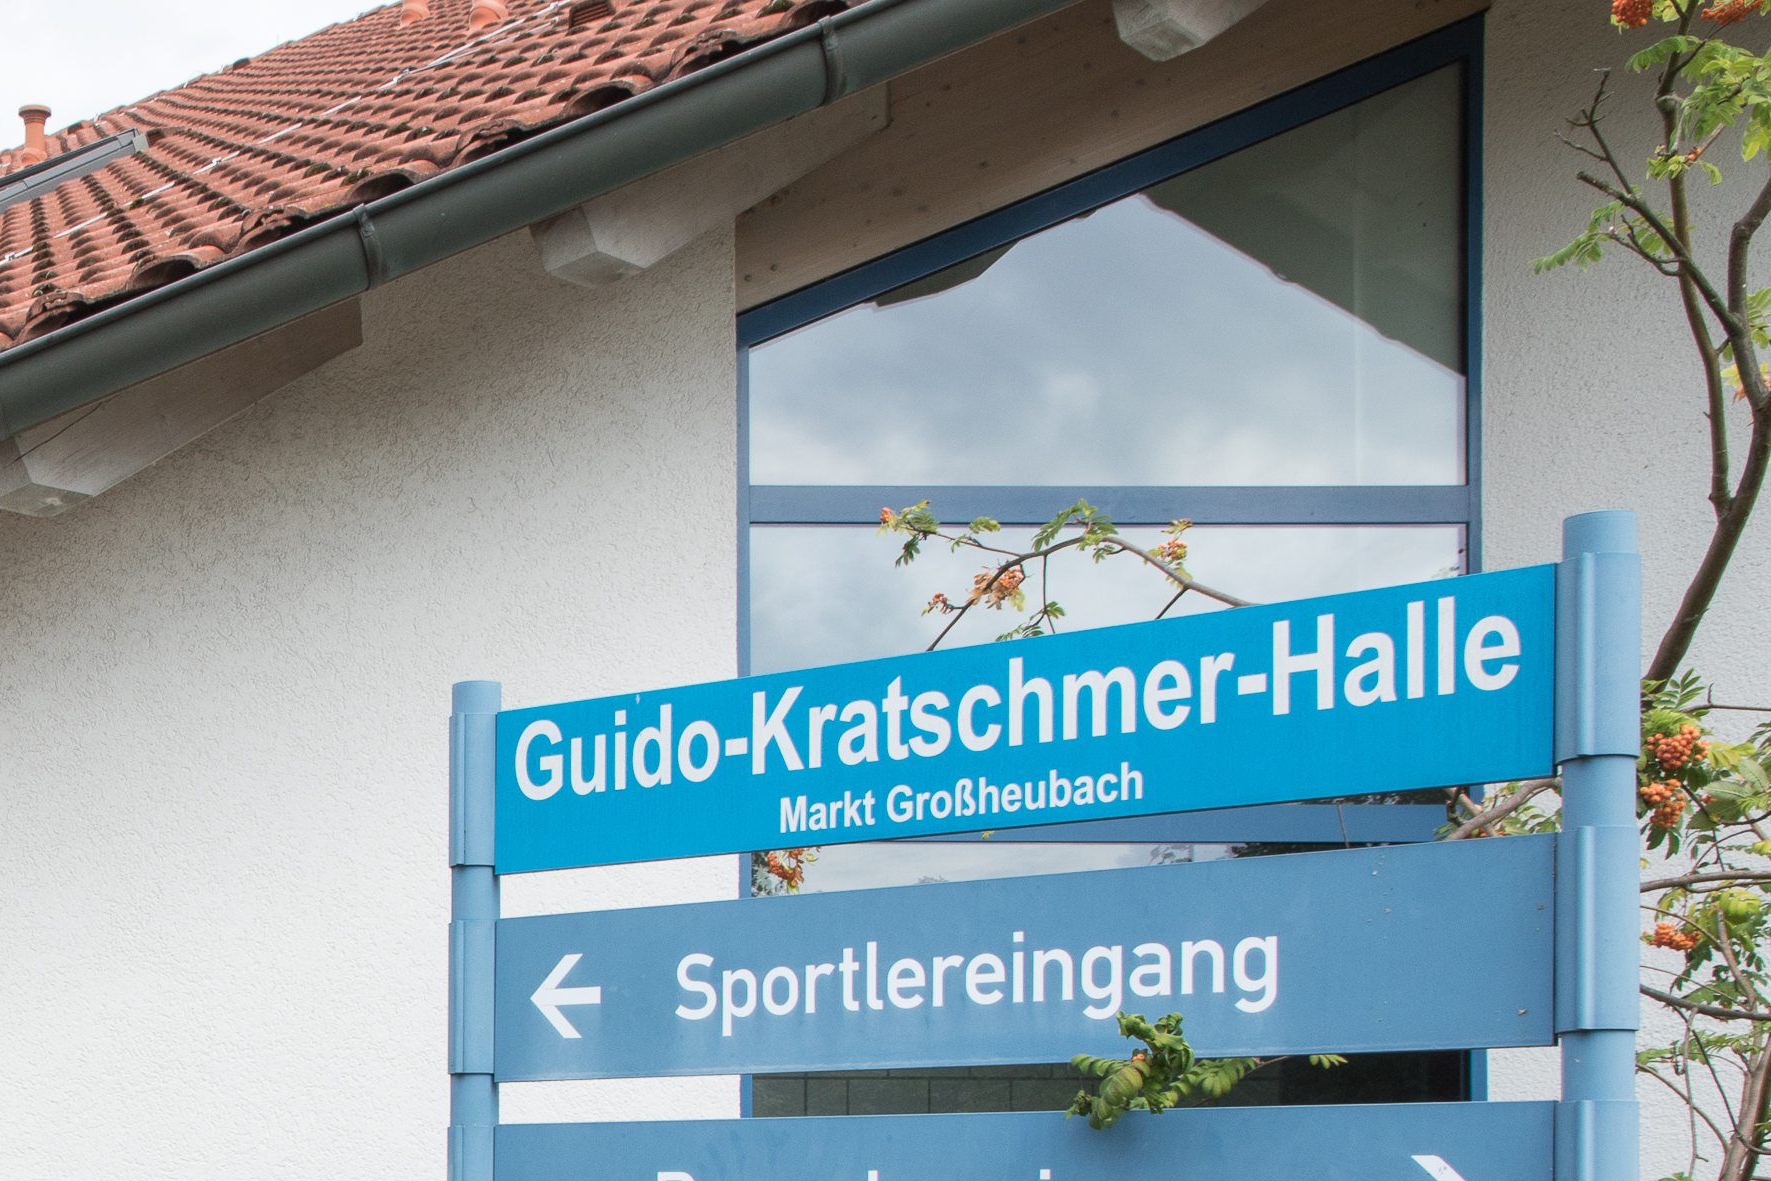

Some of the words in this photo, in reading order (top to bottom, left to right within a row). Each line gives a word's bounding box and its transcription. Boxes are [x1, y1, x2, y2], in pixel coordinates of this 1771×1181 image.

[514, 595, 1522, 802] Guido-Kratschmer-Halle
[780, 789, 876, 834] Markt
[886, 761, 1145, 823] Großheubach
[674, 930, 1280, 1037] Sportlereingang
